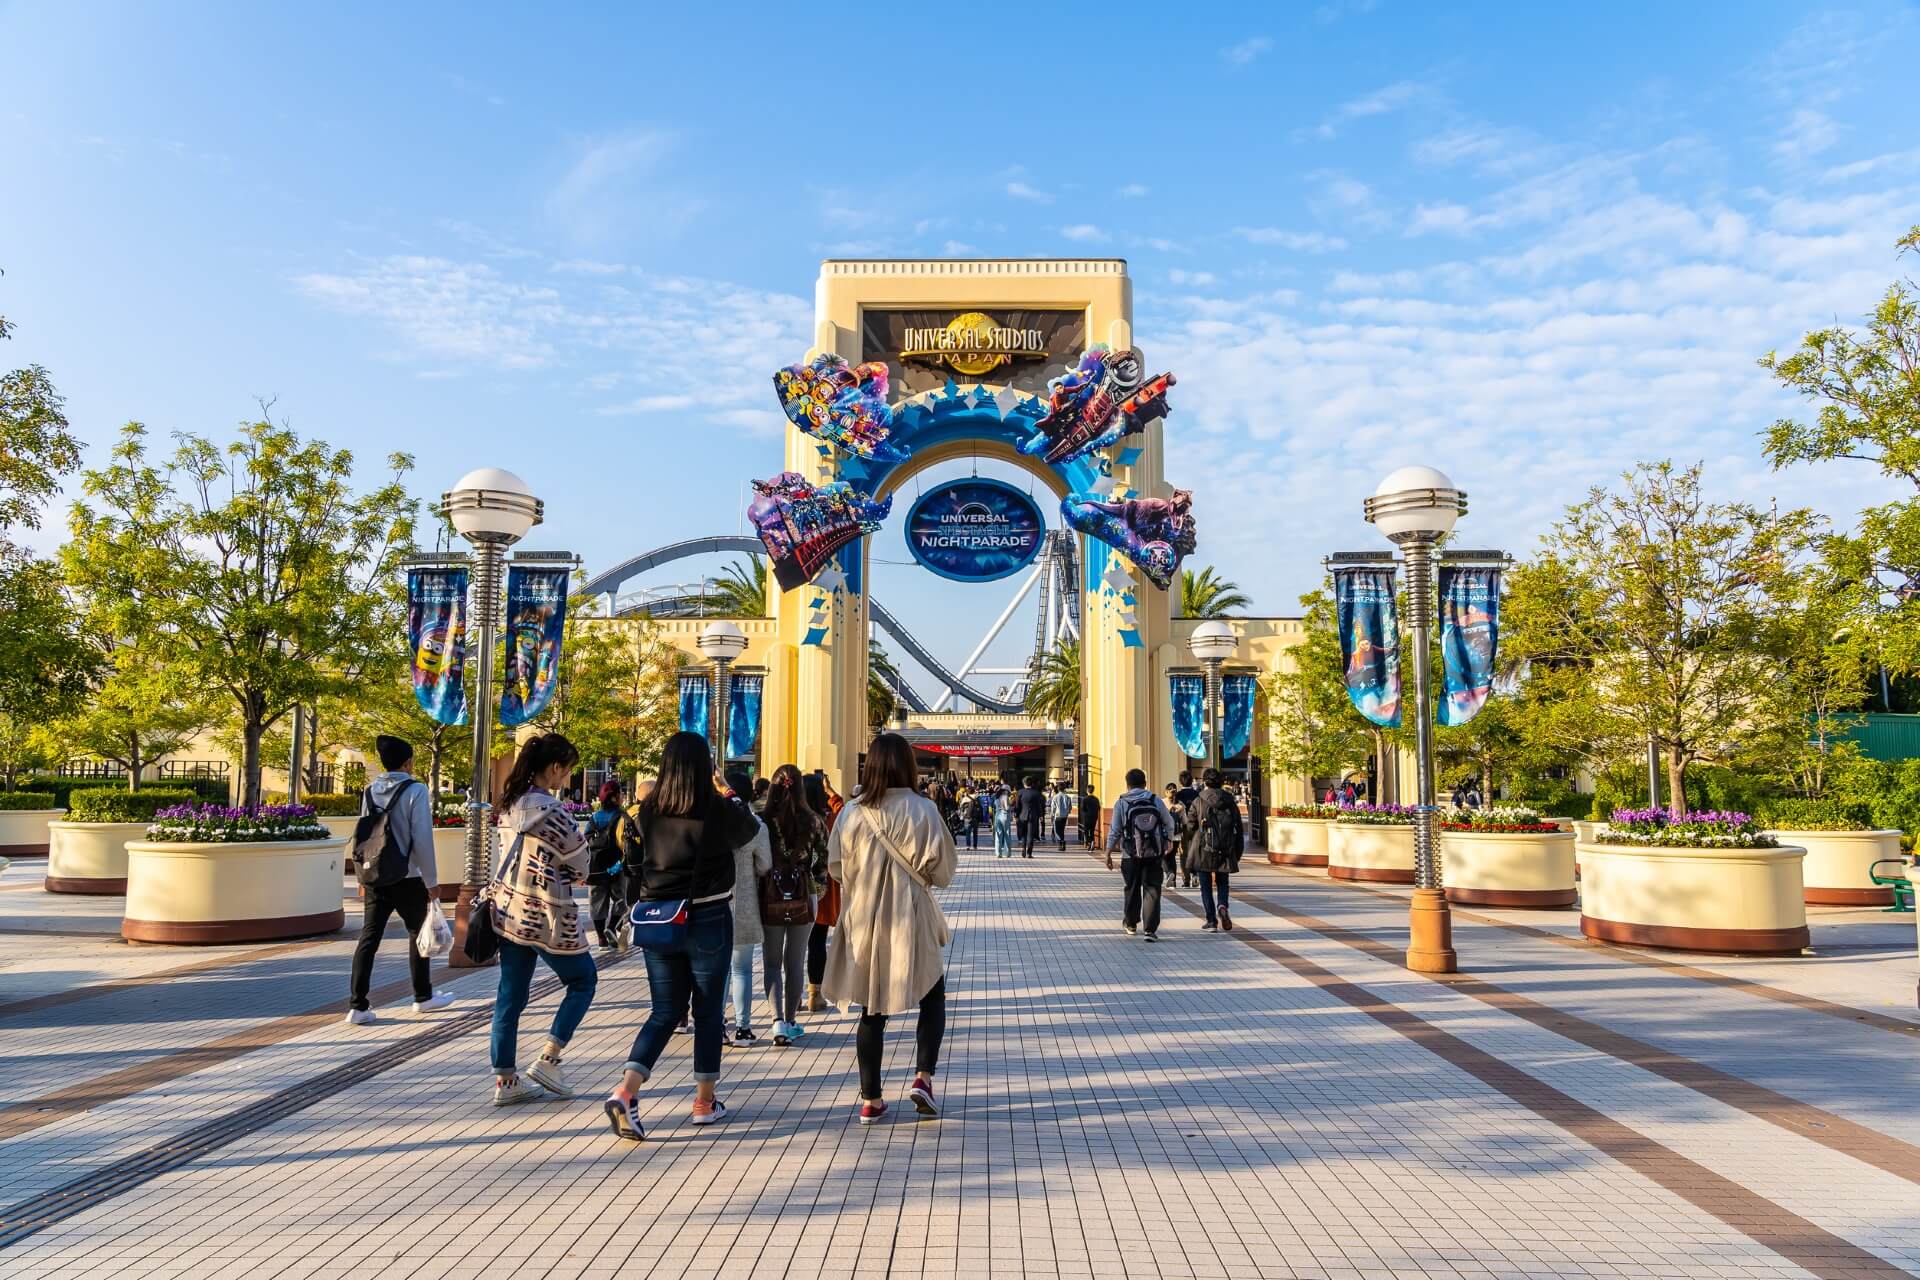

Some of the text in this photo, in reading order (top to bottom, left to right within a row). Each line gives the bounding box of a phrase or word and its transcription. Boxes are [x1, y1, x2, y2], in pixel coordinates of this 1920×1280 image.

[904, 327, 1044, 351] UNIVERSAL STUDIOS
[935, 353, 1012, 364] JAPAN
[941, 514, 1009, 523] UNIVERSAL
